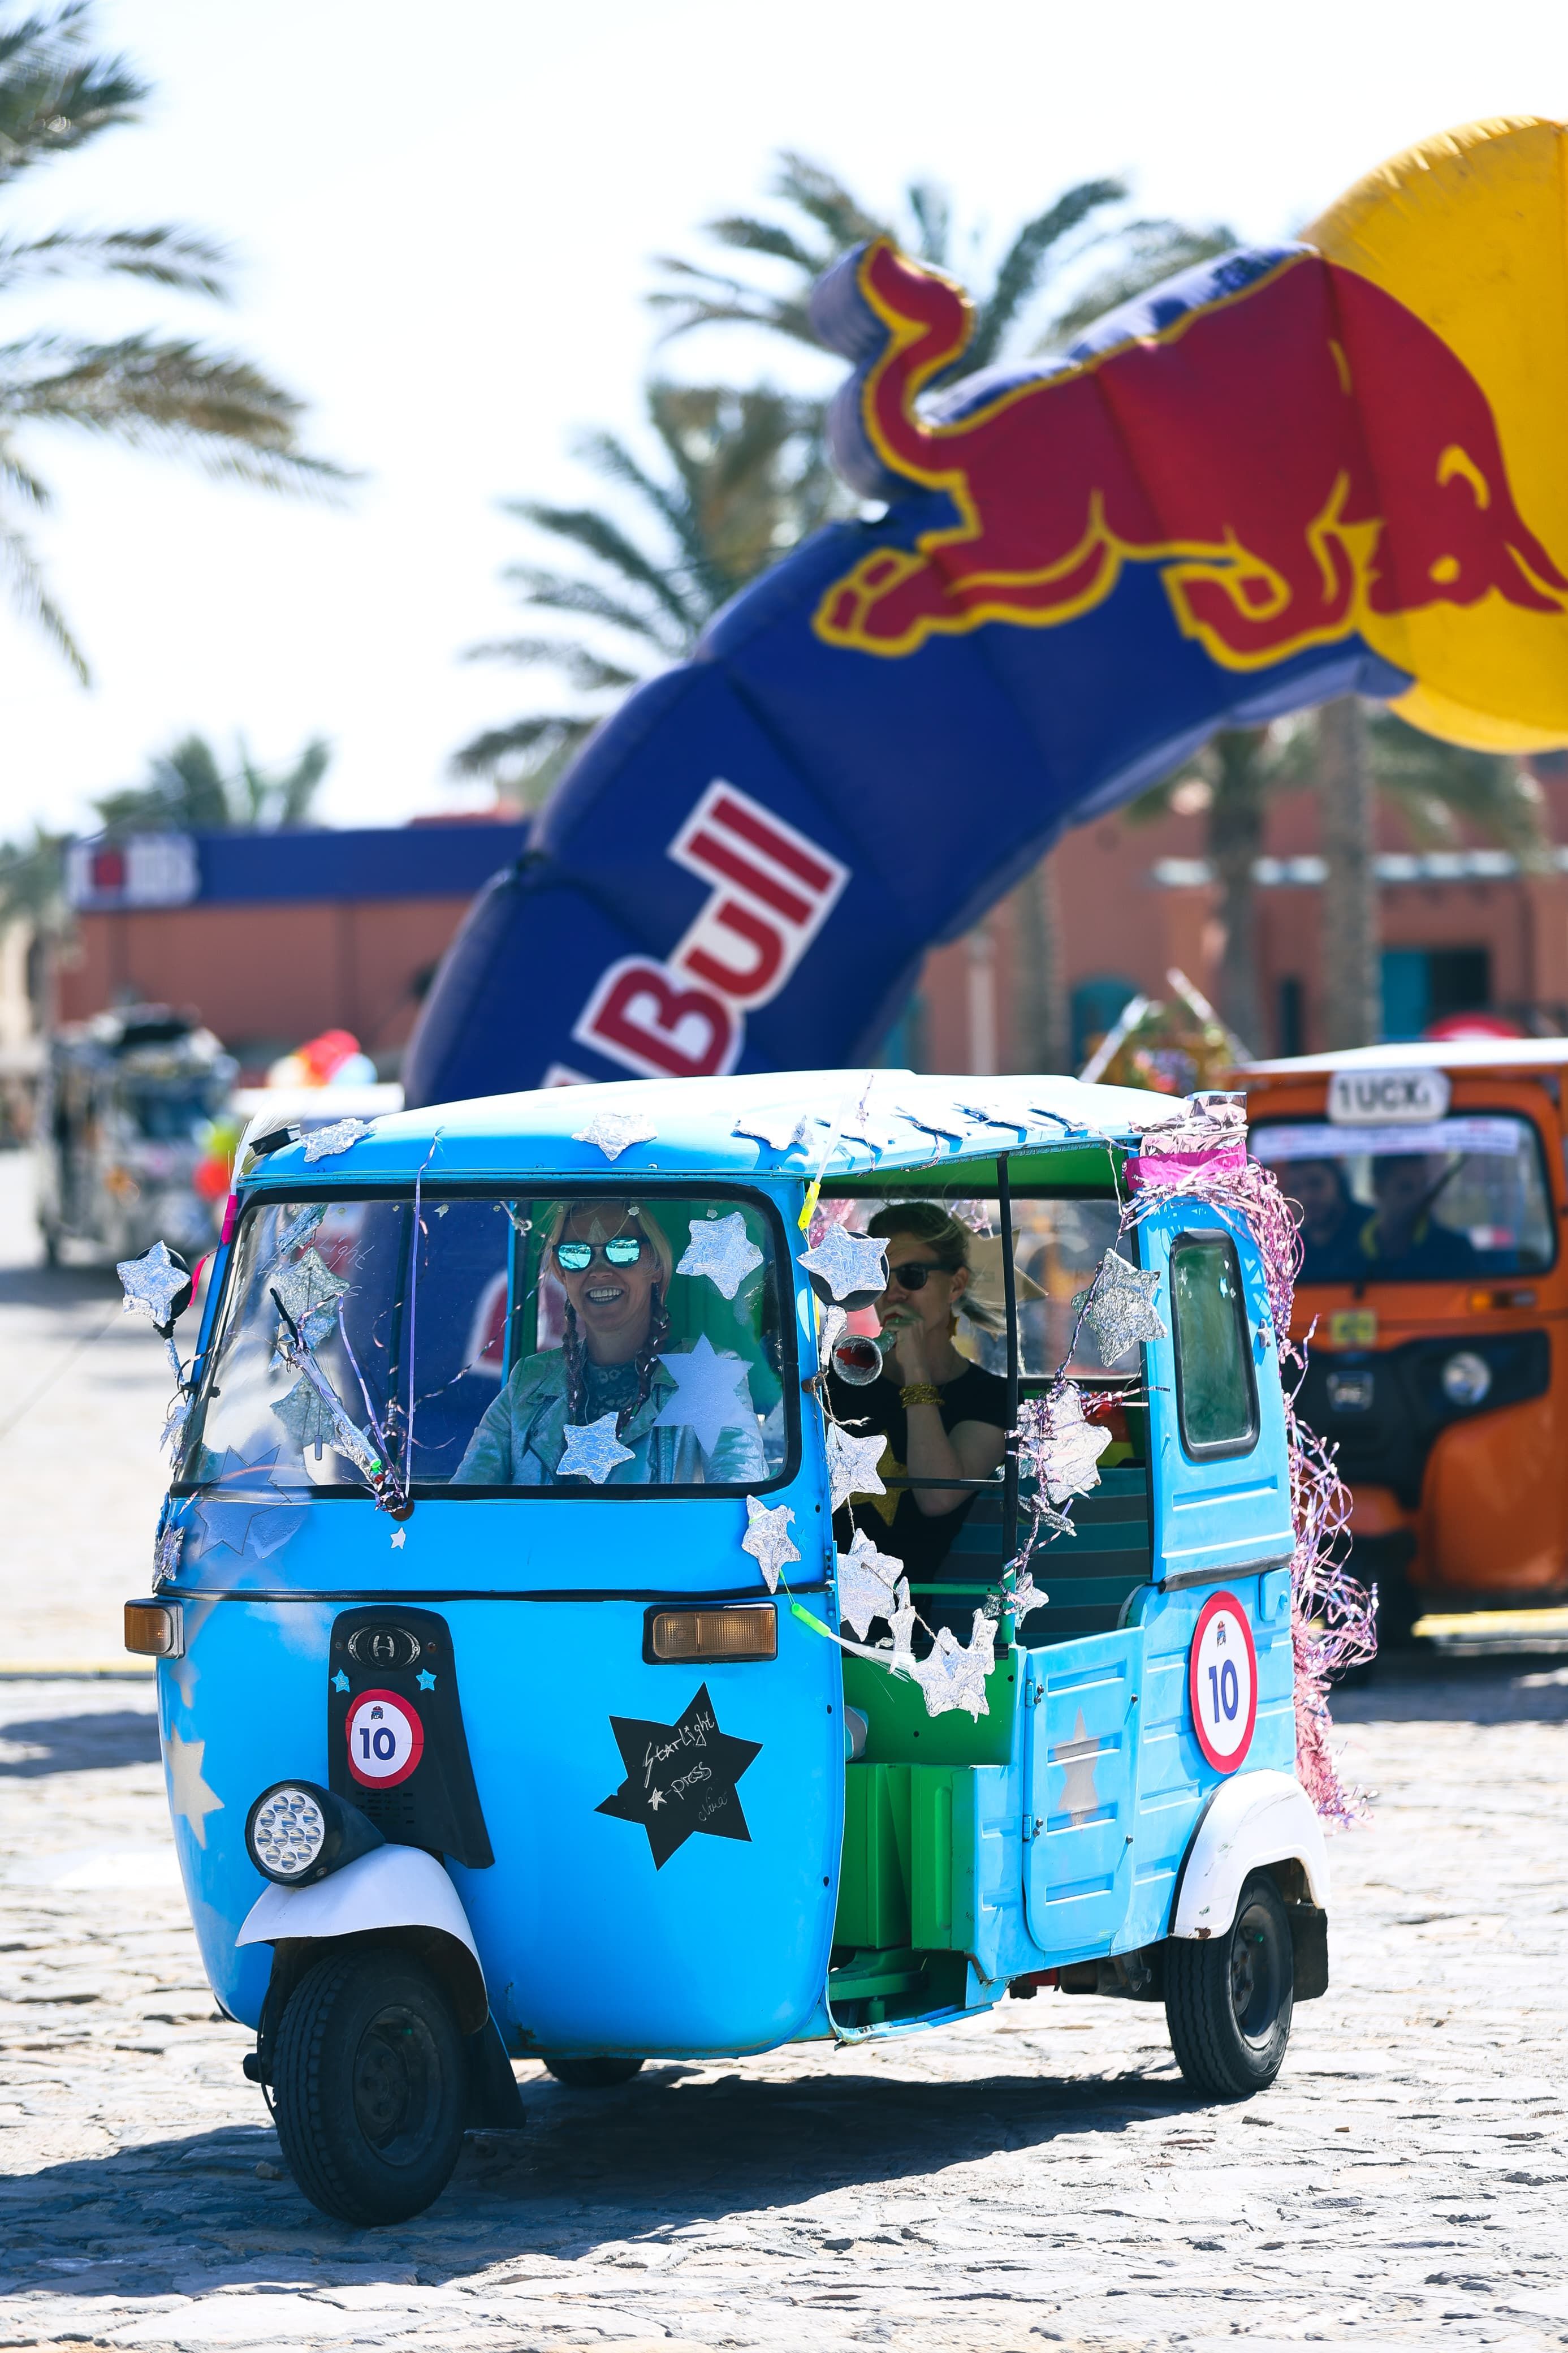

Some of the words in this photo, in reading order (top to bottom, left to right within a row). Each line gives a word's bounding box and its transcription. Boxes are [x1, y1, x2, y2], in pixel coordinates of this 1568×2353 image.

[585, 791, 841, 1077] Bull
[1208, 1659, 1238, 1723] 10
[359, 1727, 396, 1761] 10
